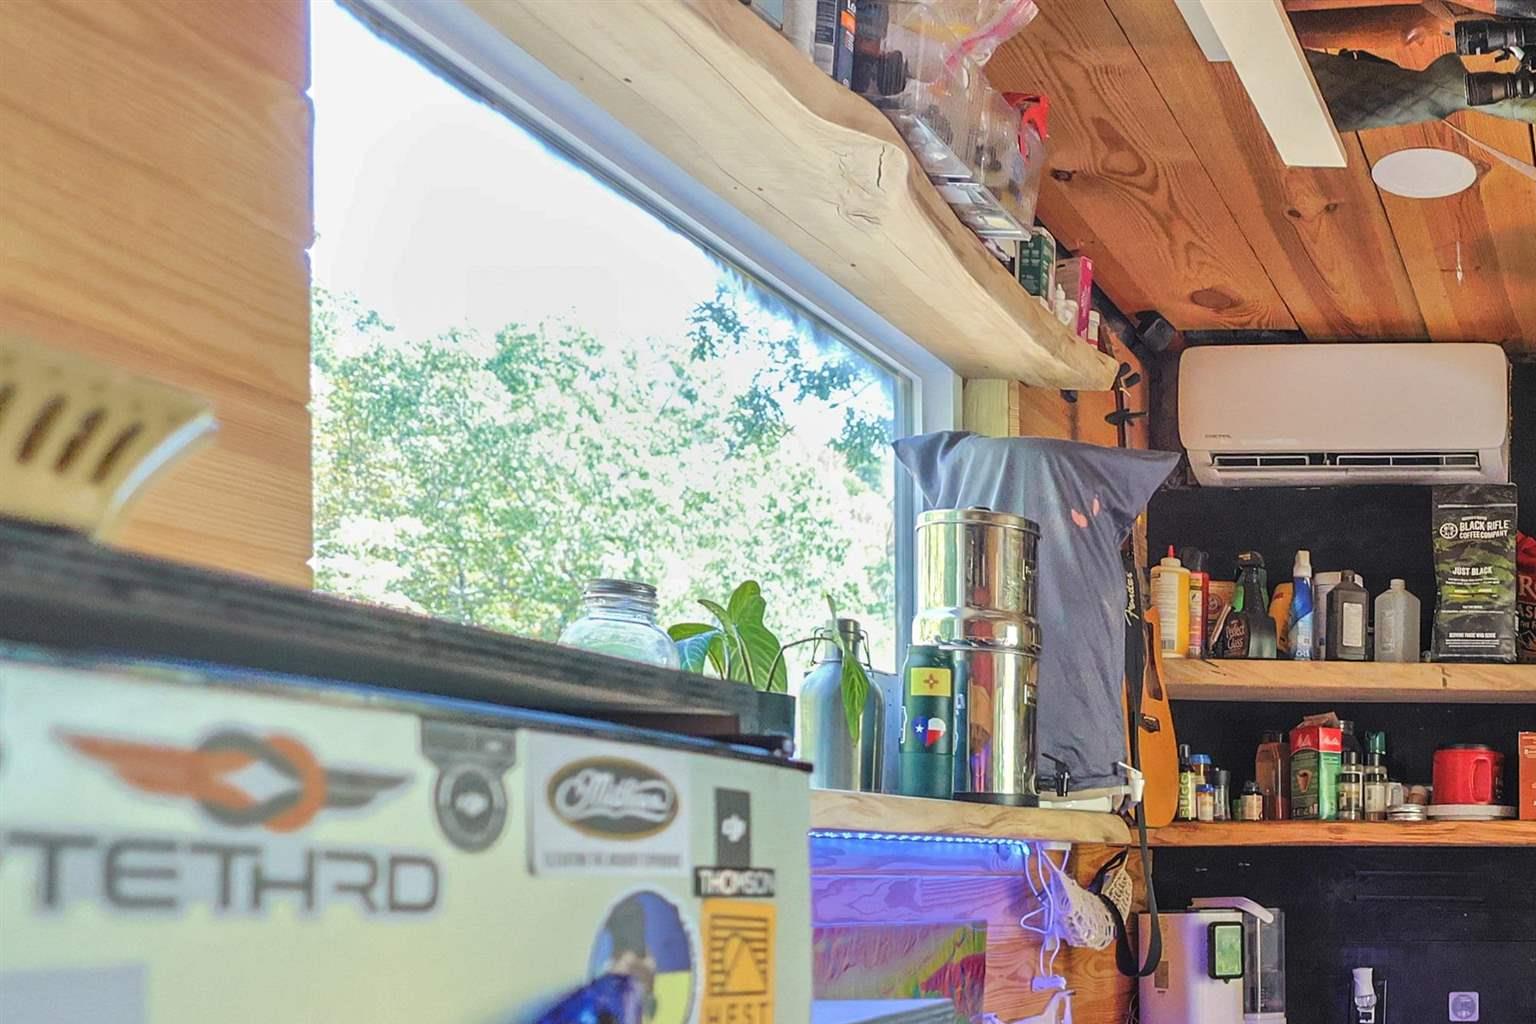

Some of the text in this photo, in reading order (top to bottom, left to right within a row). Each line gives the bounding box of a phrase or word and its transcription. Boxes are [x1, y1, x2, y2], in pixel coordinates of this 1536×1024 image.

[1460, 520, 1511, 532] BLACK RIFLE
[1459, 529, 1508, 539] COFFEE COMPANY
[1452, 566, 1493, 576] JUST BLACK
[6, 829, 441, 914] TETHRD
